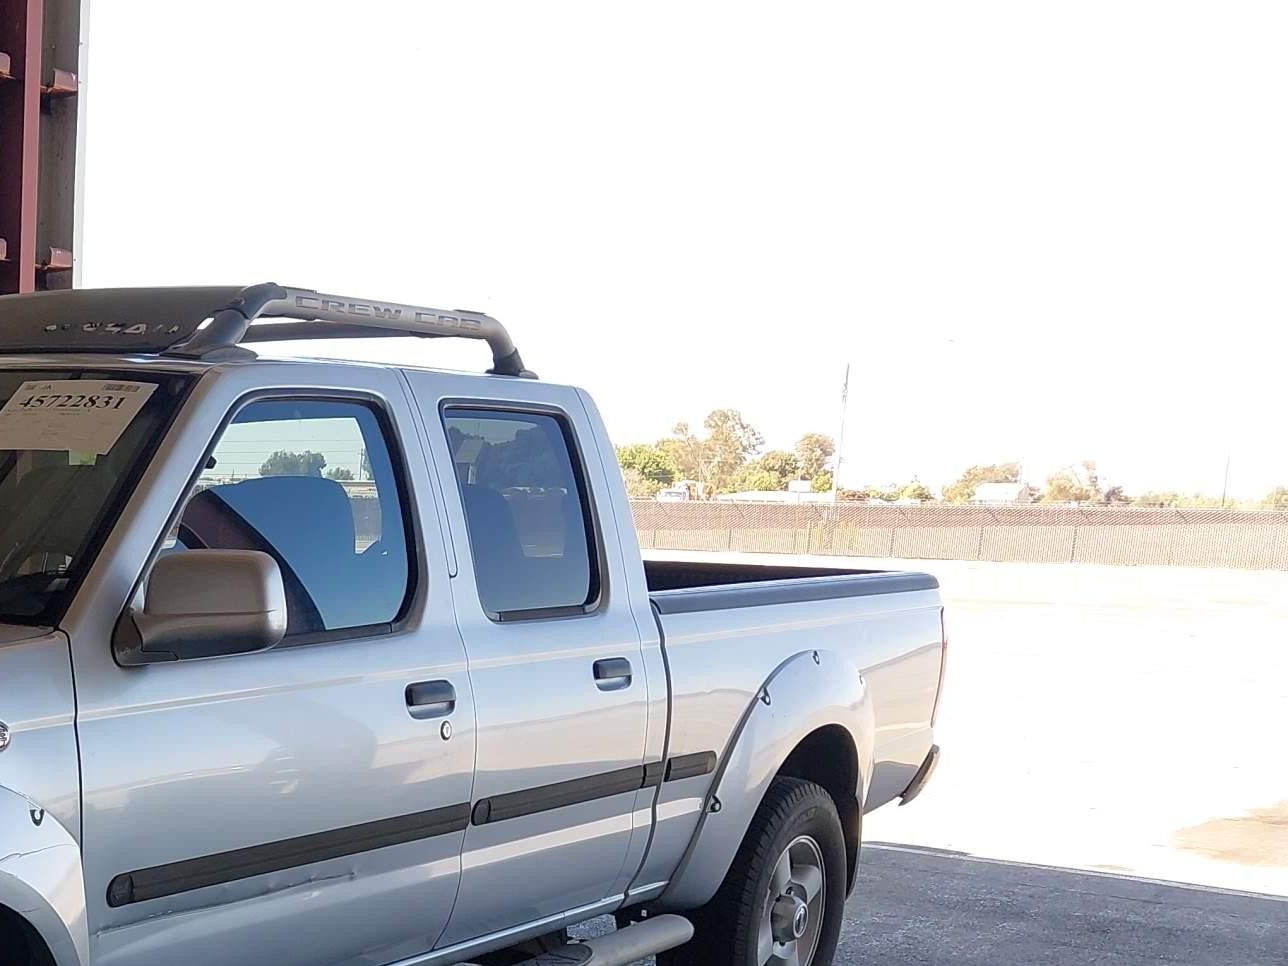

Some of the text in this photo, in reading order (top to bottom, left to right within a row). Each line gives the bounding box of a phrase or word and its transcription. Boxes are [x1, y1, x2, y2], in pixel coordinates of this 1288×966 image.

[295, 294, 481, 331] CREW CAB
[18, 394, 126, 409] 45722831
